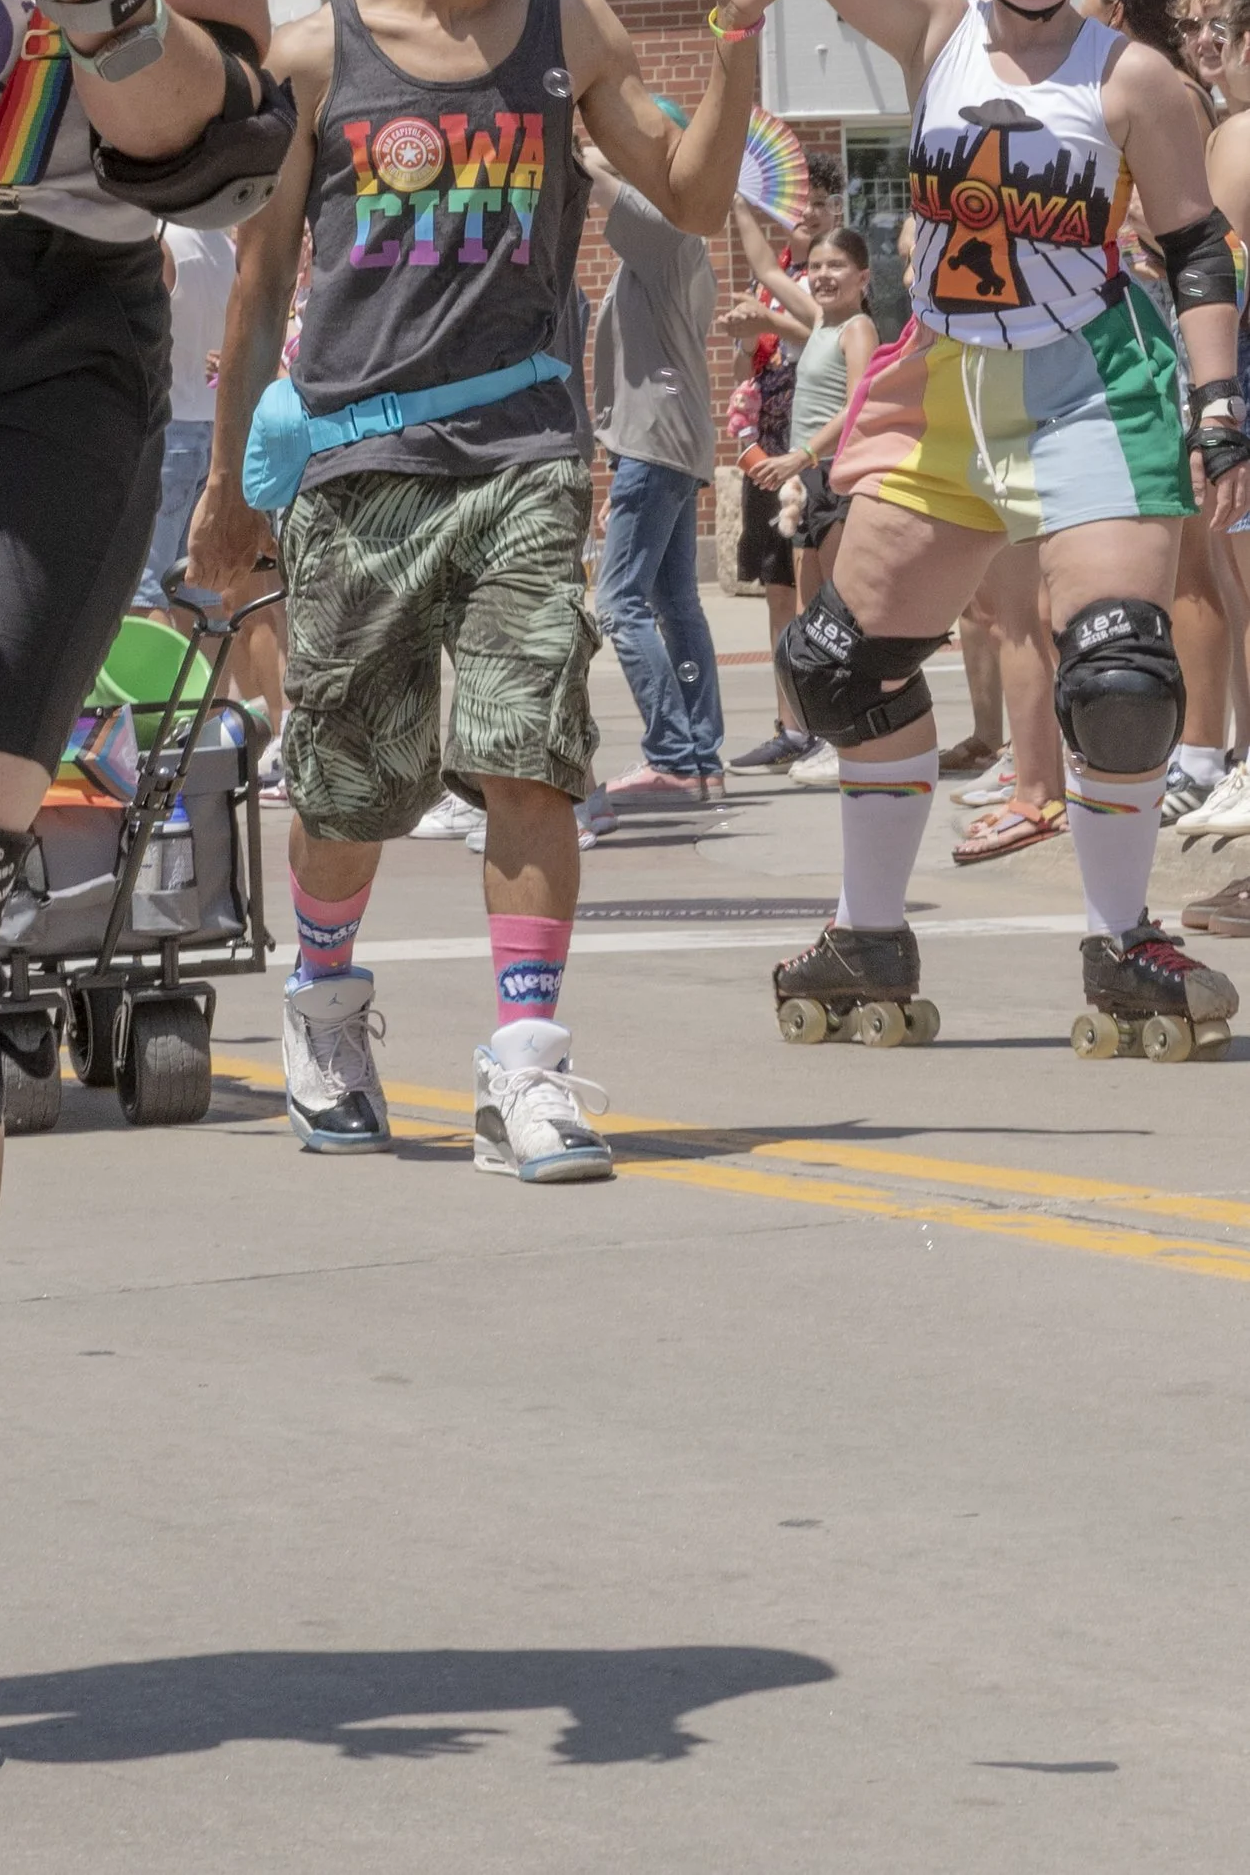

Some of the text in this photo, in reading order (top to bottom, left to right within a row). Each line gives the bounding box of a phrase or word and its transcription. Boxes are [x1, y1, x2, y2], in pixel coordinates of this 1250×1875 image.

[343, 113, 544, 196] IOWA
[350, 188, 540, 269] CITY
[1081, 609, 1125, 638] 187
